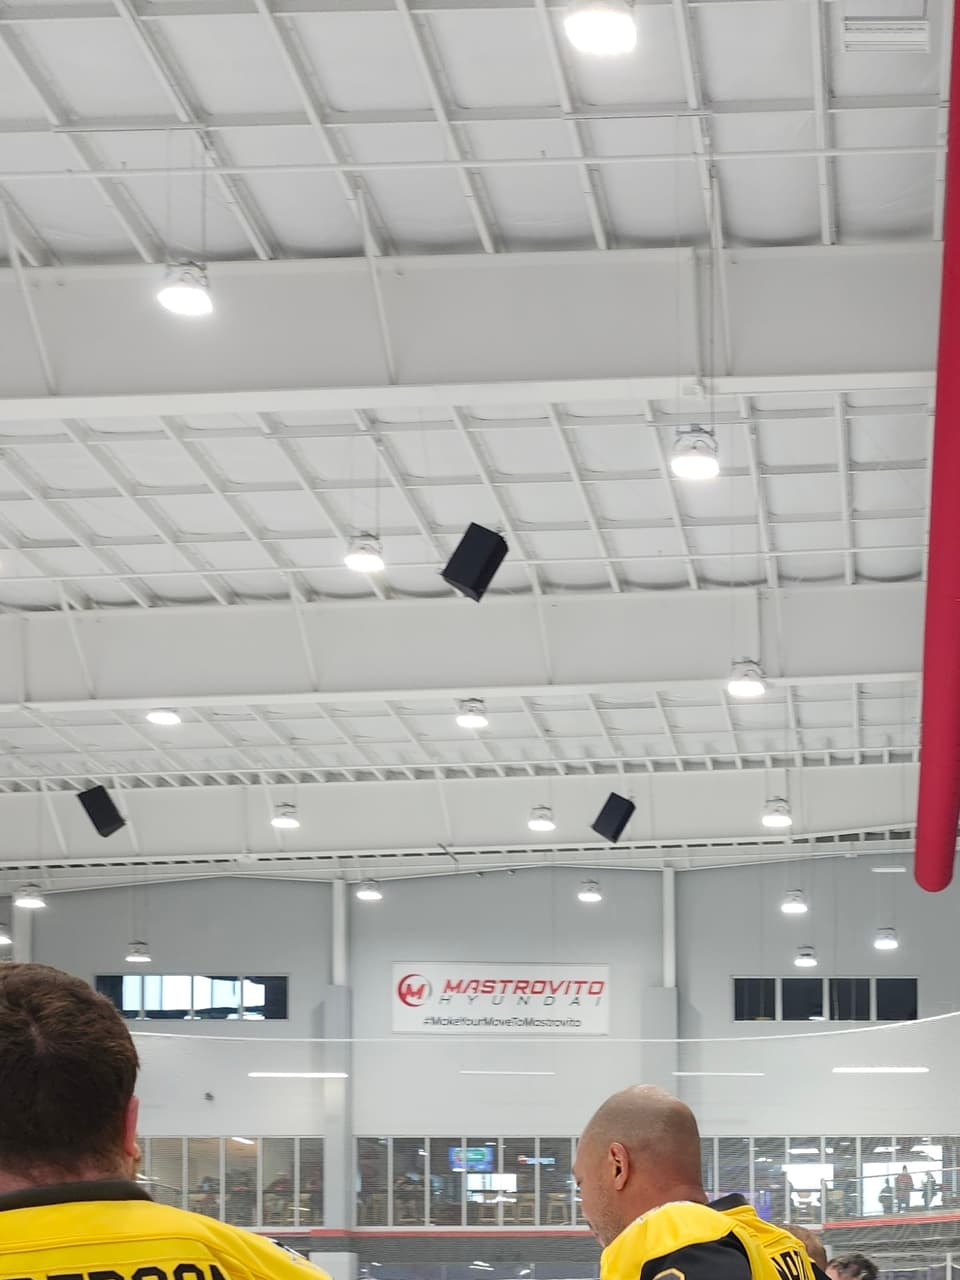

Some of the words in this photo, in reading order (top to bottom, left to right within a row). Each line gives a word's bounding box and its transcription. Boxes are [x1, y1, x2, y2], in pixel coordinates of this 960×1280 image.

[442, 978, 605, 995] MASTROVITO
[438, 994, 602, 1007] HYUNDAI
[423, 1016, 582, 1028] #MakeYourMoveToMastrovito
